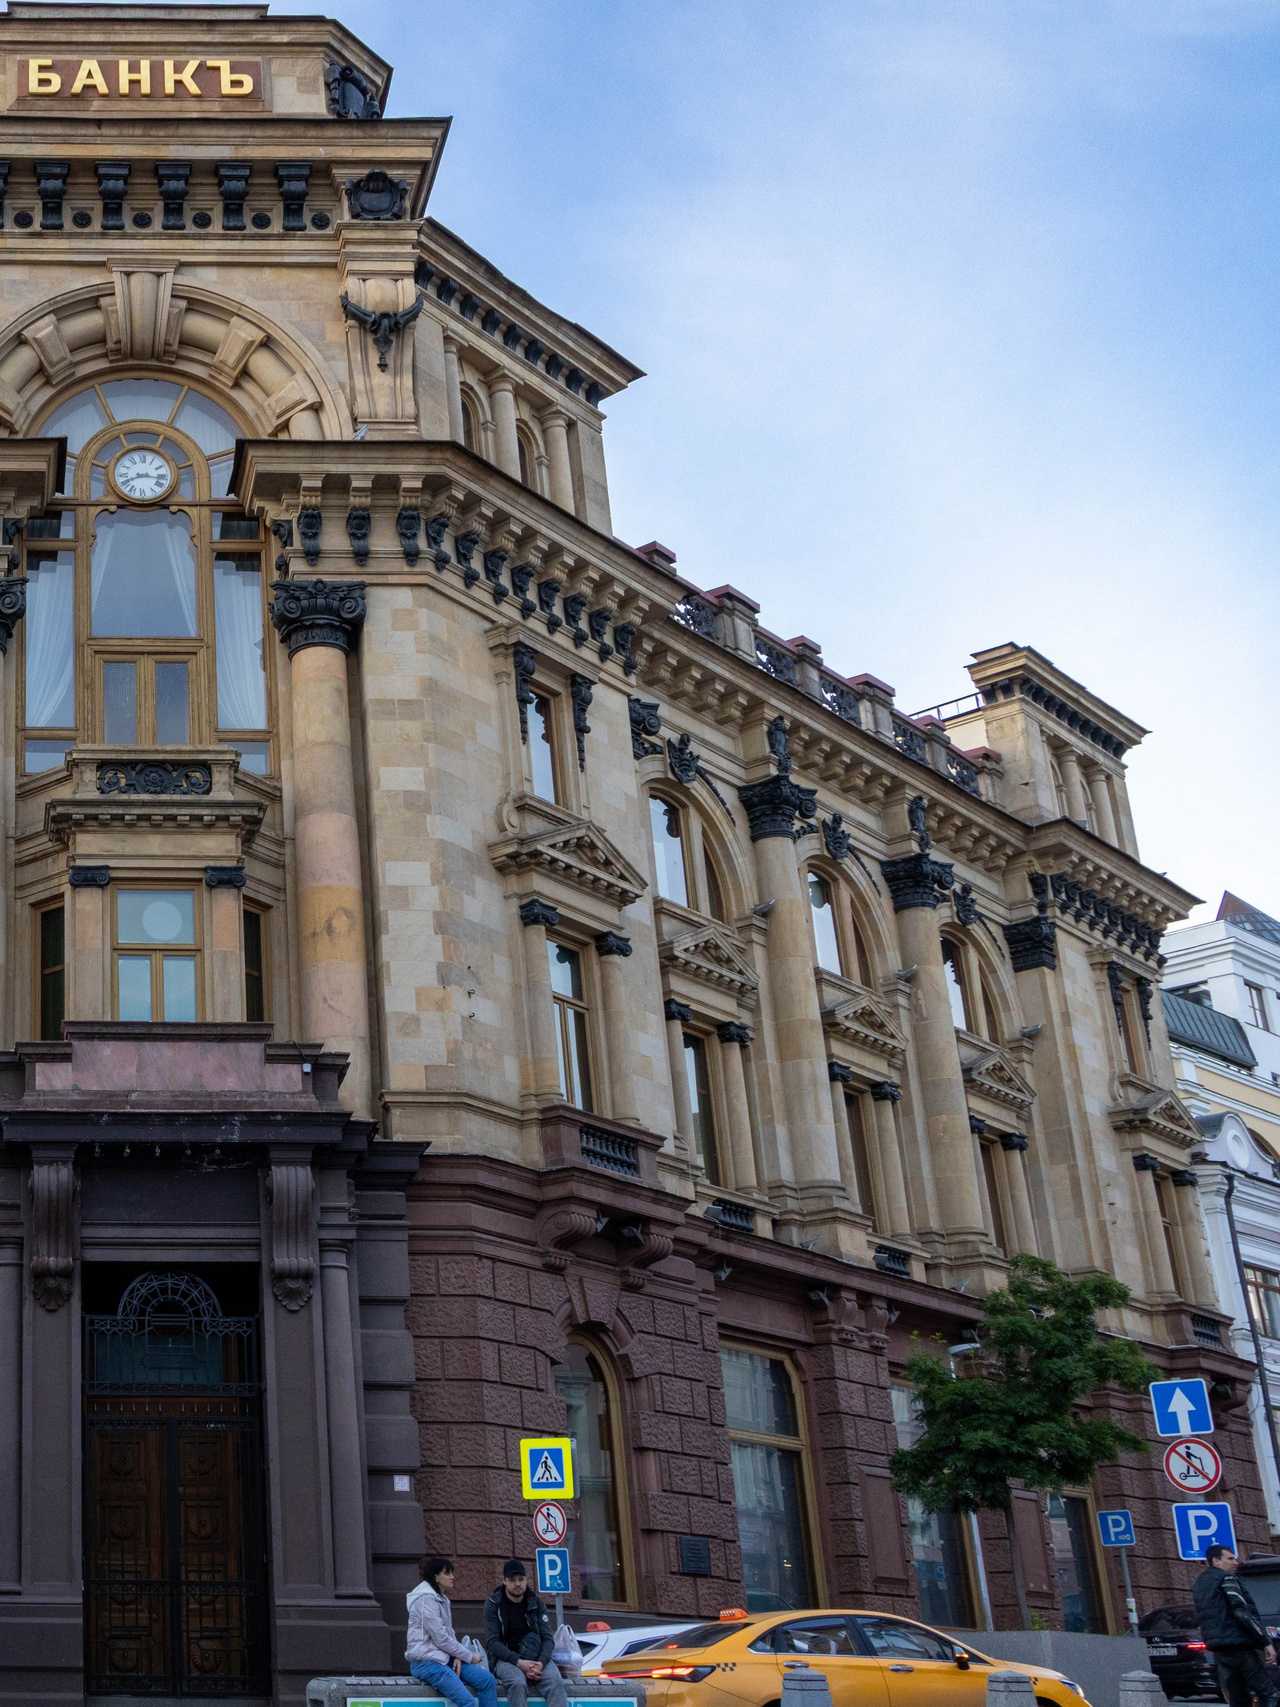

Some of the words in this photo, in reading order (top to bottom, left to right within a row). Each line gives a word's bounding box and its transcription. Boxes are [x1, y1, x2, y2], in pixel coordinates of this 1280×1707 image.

[28, 58, 254, 97] БАНКЪ
[1107, 1515, 1126, 1542] P
[1187, 1509, 1219, 1551] P
[544, 1554, 562, 1588] P
